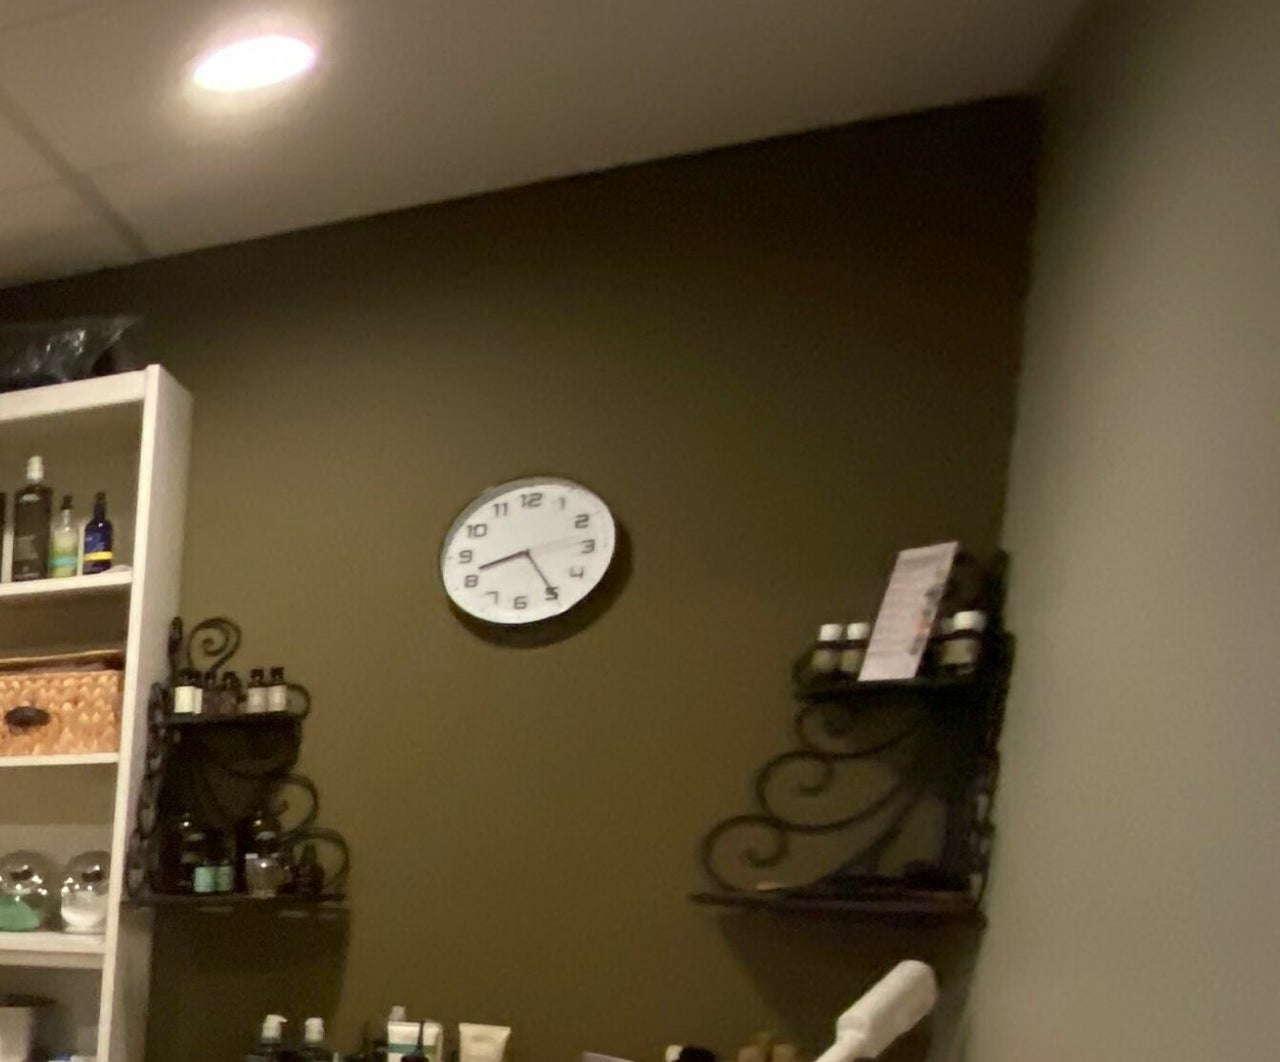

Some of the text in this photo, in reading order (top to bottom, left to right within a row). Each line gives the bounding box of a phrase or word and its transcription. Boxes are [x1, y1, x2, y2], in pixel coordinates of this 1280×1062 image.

[520, 493, 543, 507] 12
[558, 497, 566, 511] 1
[493, 503, 509, 517] 11
[574, 514, 590, 529] 2
[467, 523, 488, 538] 10
[582, 539, 596, 554] 3
[458, 550, 473, 564] 9
[569, 566, 584, 579] 4
[463, 575, 479, 588] 8
[485, 591, 499, 604] 7
[545, 586, 559, 601] 5
[513, 596, 528, 610] 6
